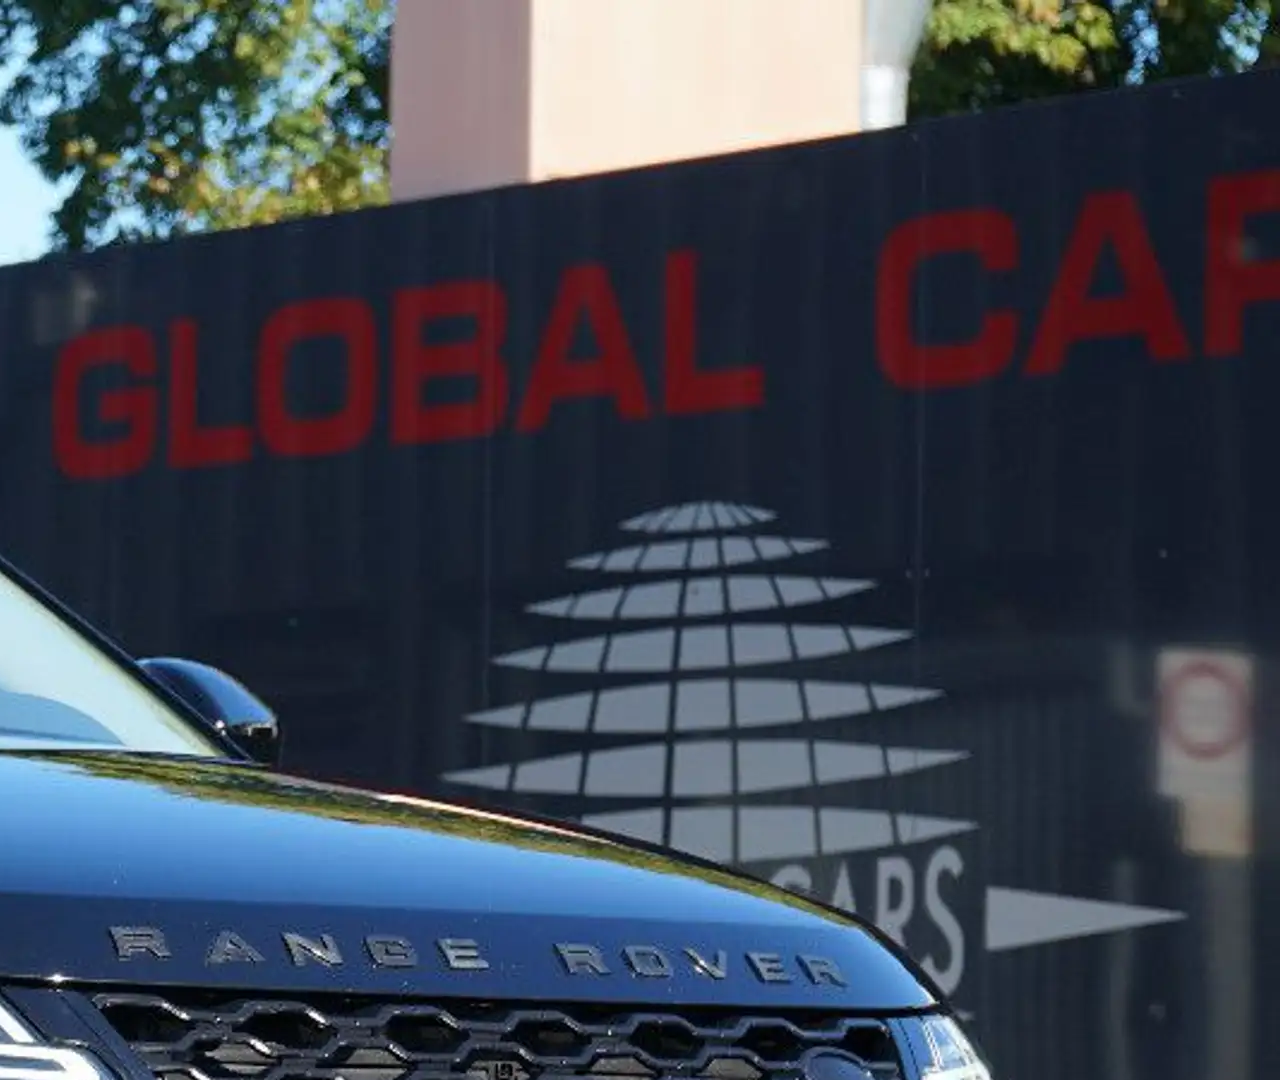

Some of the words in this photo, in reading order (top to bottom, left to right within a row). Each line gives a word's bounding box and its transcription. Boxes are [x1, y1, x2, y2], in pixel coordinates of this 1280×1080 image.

[52, 248, 766, 480] GLOBAL
[108, 926, 490, 969] RANGE
[552, 943, 849, 988] ROVER
[769, 845, 964, 996] RS
